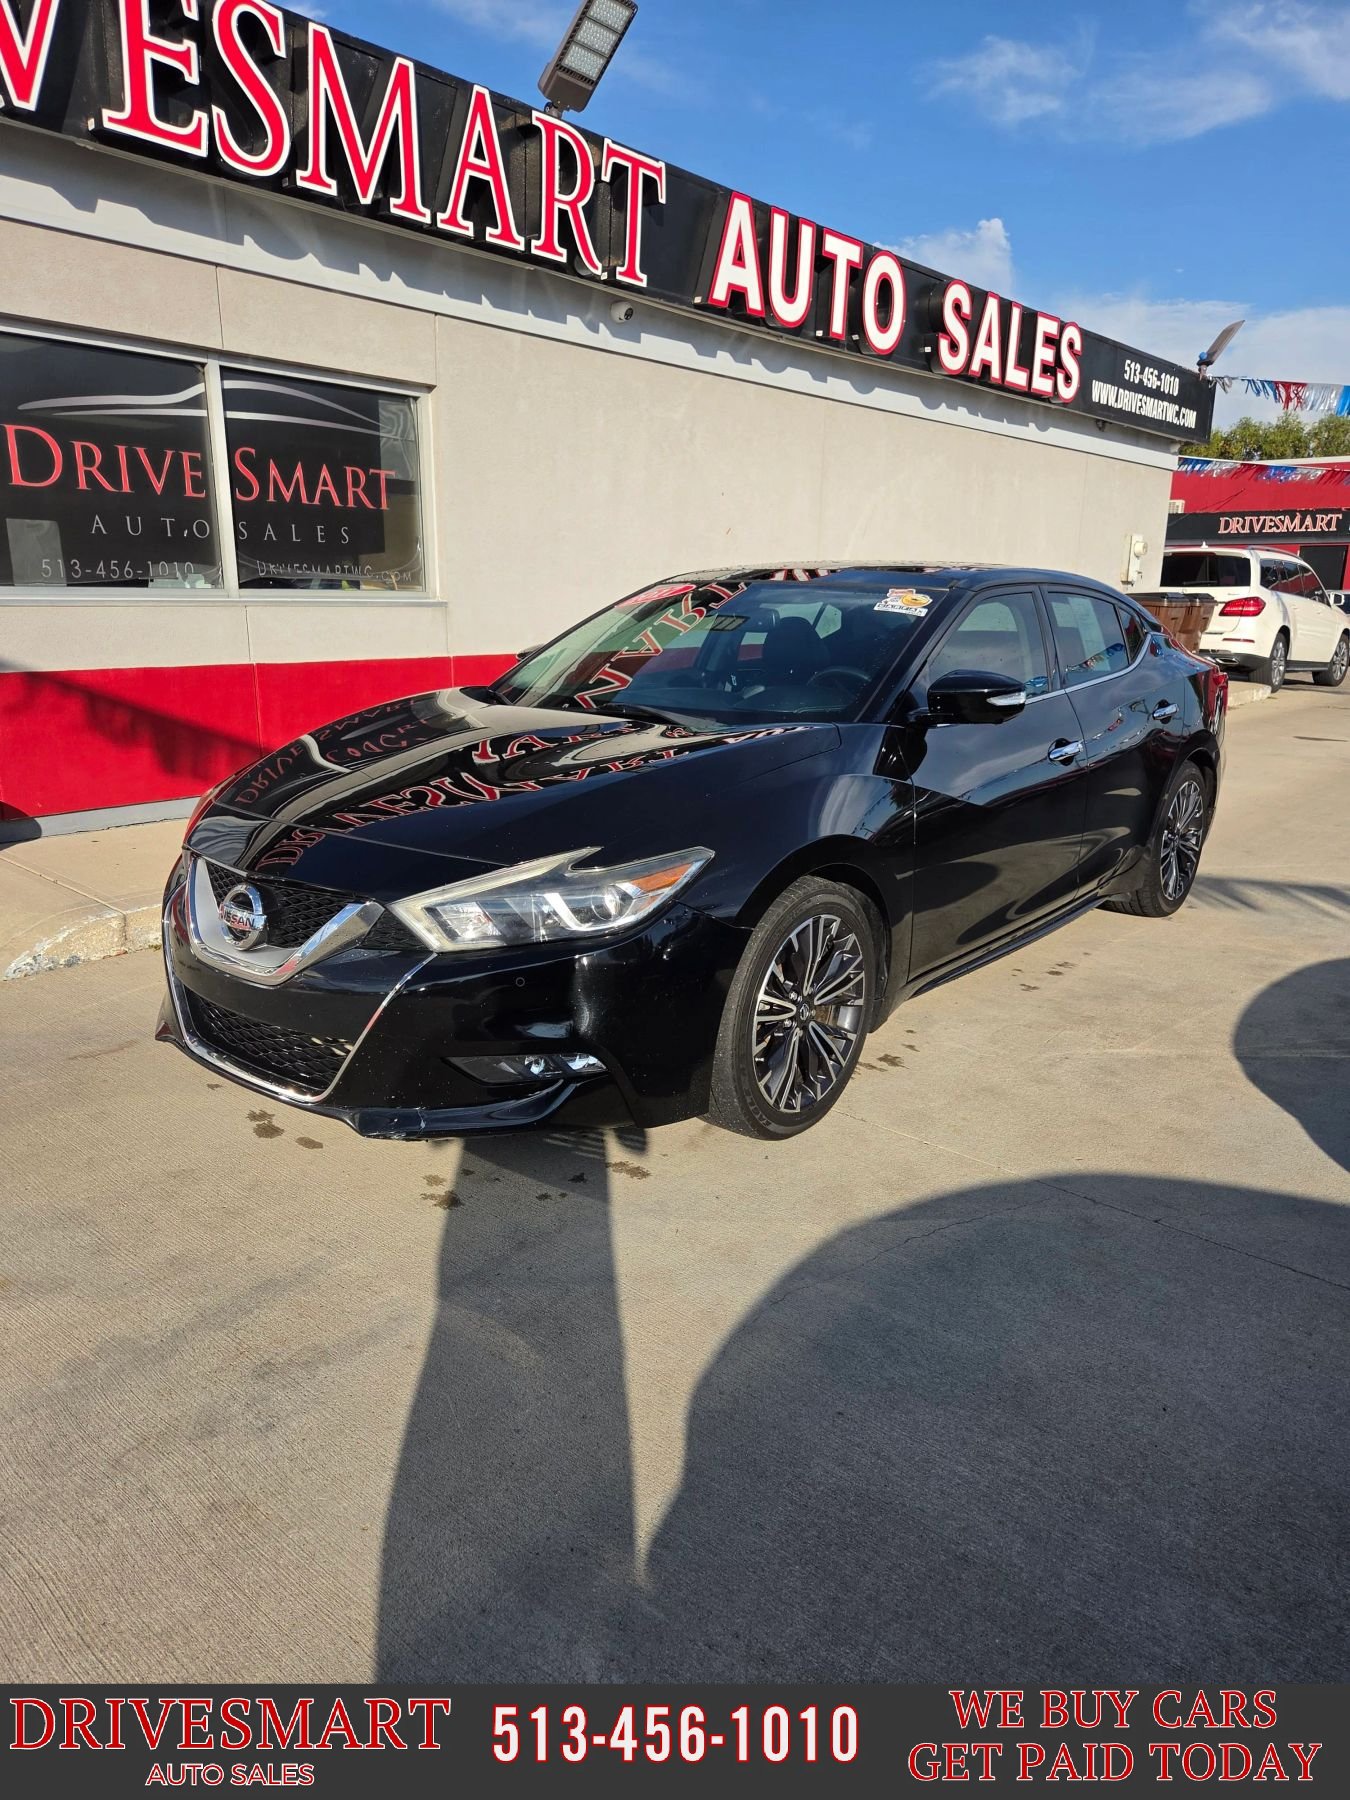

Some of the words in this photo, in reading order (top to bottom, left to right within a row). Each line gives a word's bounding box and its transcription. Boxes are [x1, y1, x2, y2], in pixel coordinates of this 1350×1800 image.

[708, 190, 907, 356] AUTO
[937, 279, 1083, 404] SALES
[1123, 359, 1179, 397] 513-456-1010
[1091, 380, 1197, 429] WWW.DRIVESMARTWC.COM
[91, 514, 210, 539] AUTO
[238, 521, 350, 544] SALES
[1218, 513, 1342, 534] DRIVESMART
[41, 559, 195, 579] 513-456-1010
[219, 903, 255, 928] NISSAN
